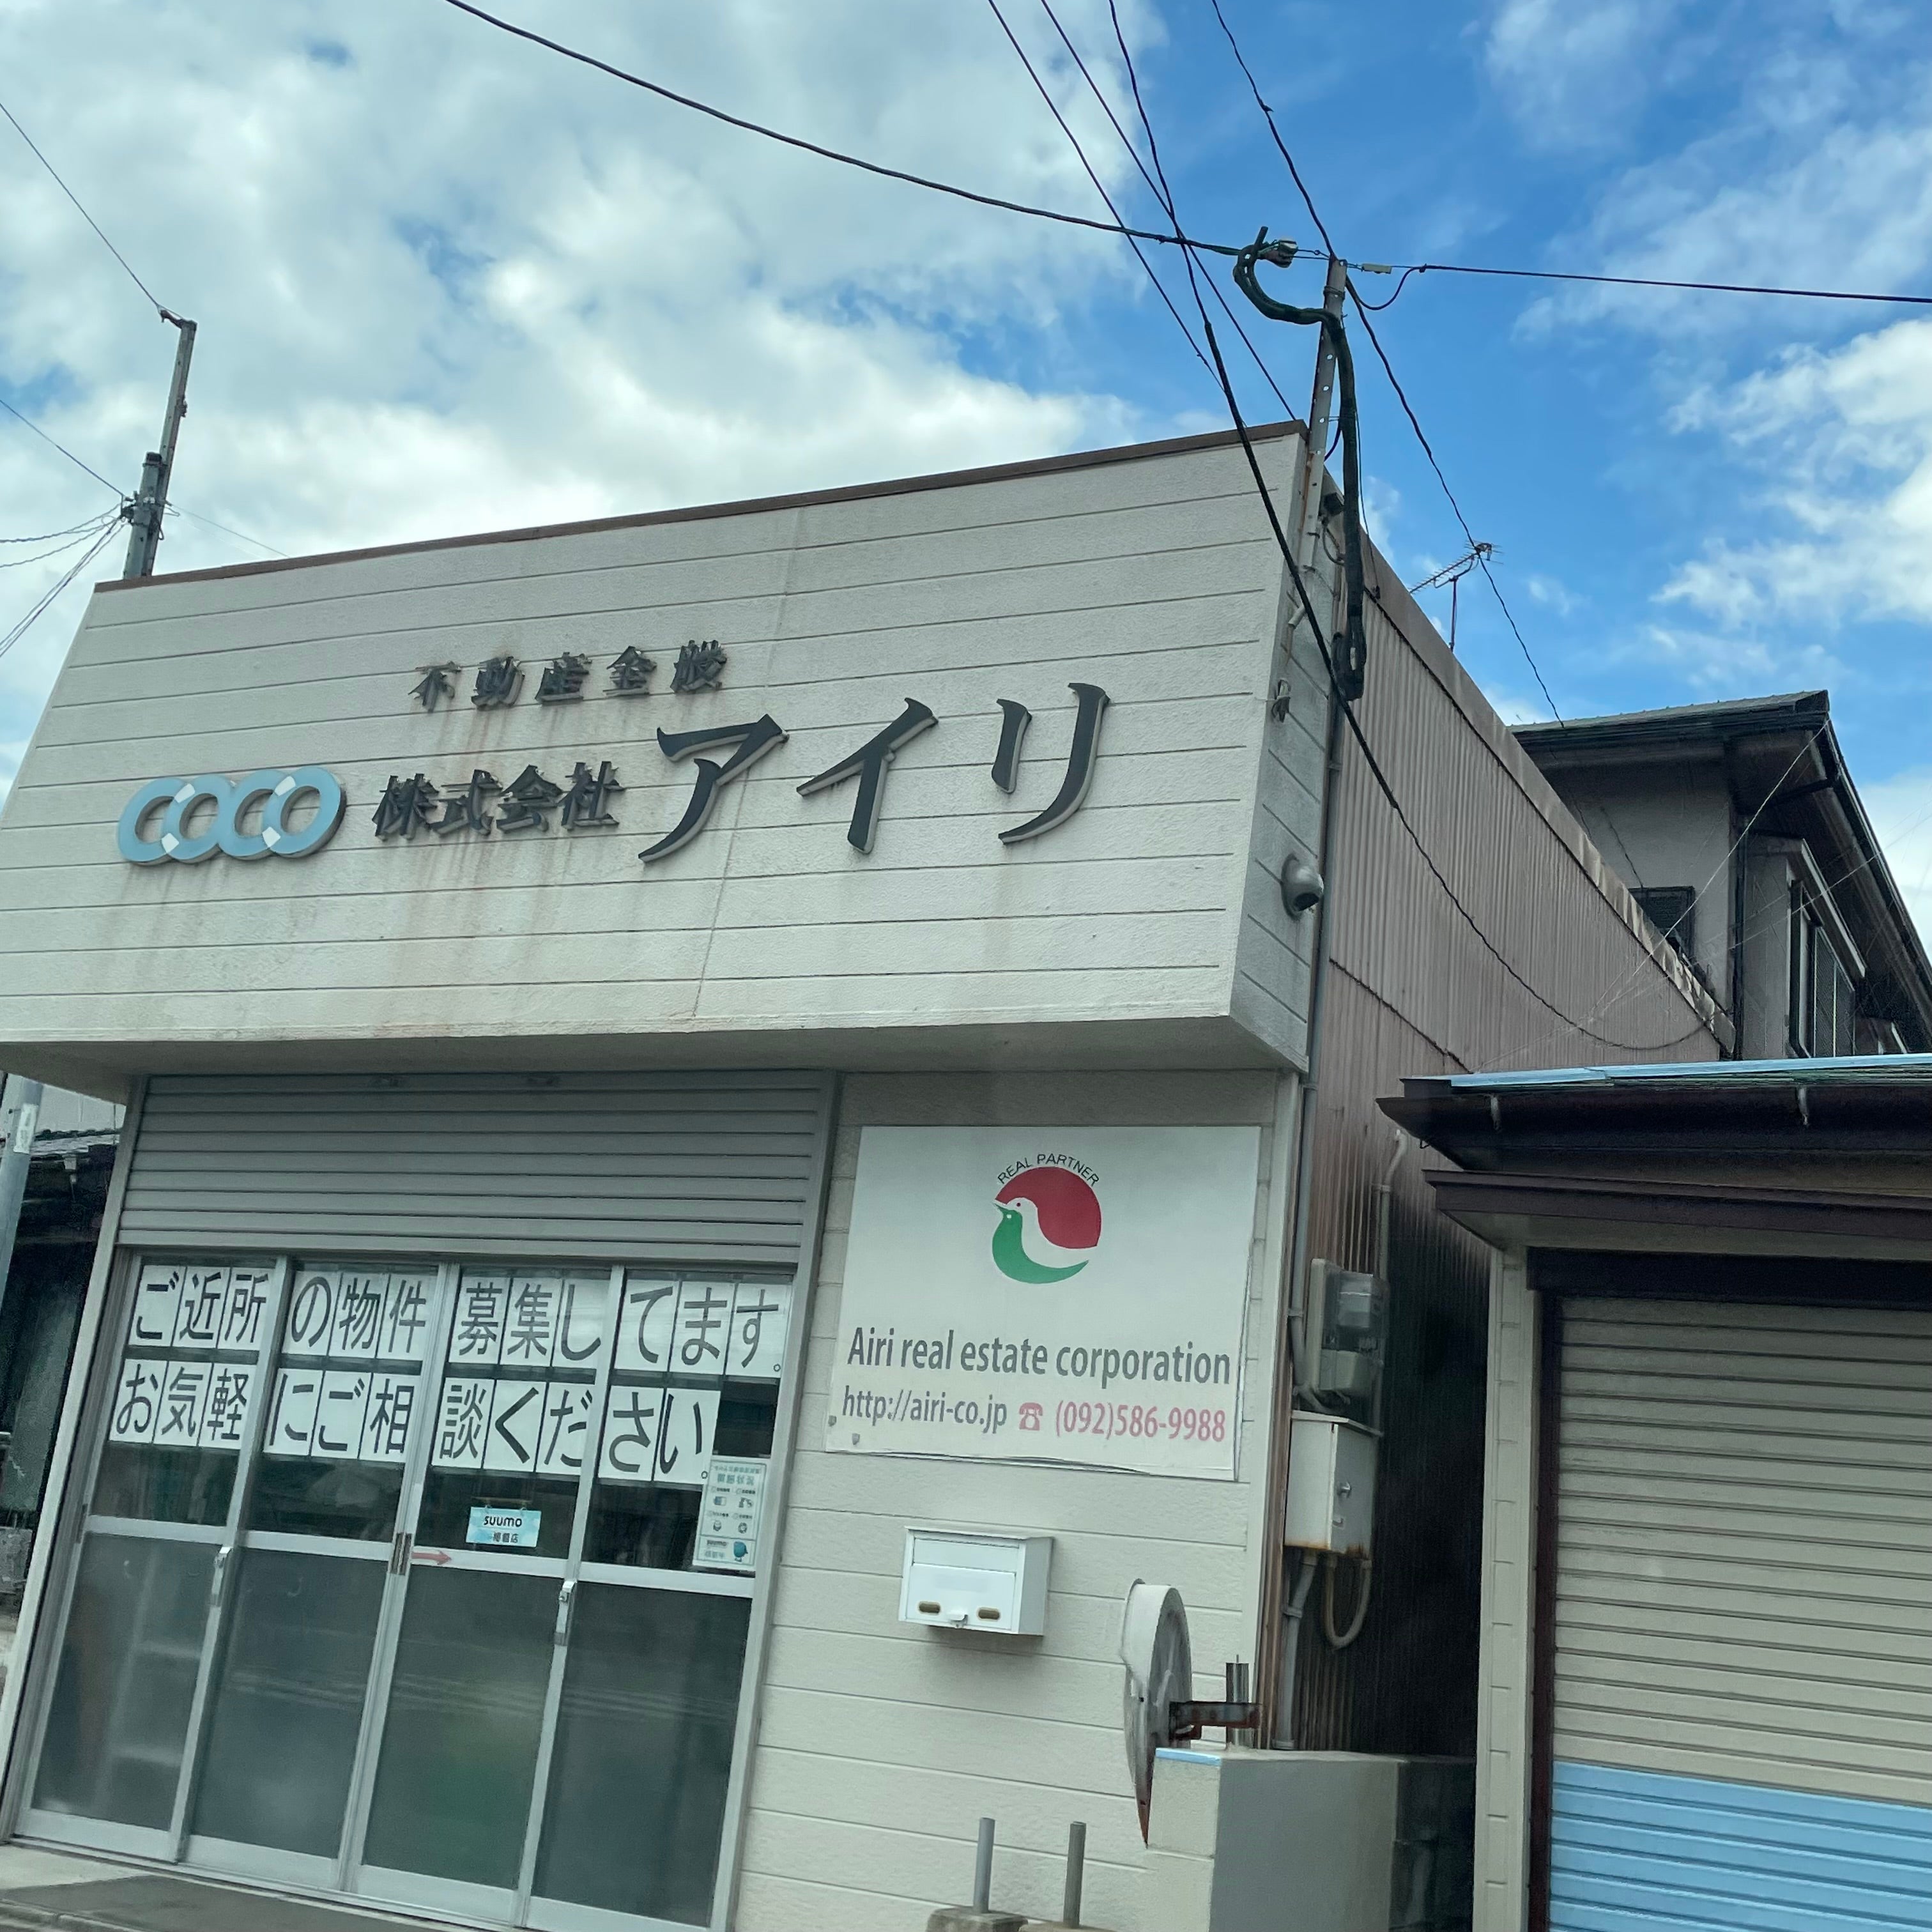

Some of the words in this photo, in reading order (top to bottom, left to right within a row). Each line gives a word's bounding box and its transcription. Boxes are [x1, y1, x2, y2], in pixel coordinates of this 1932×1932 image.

[372, 682, 1111, 863] 株式会社アイリ
[997, 1157, 1033, 1184] REAL
[1036, 1153, 1100, 1187] PARTNER
[847, 1326, 895, 1367] Airi
[900, 1329, 954, 1370] real
[960, 1337, 1048, 1375] estate
[1055, 1340, 1230, 1390] corporation
[841, 1384, 1008, 1434] http://airi-co.jp
[1055, 1400, 1226, 1443] (092)586-9988
